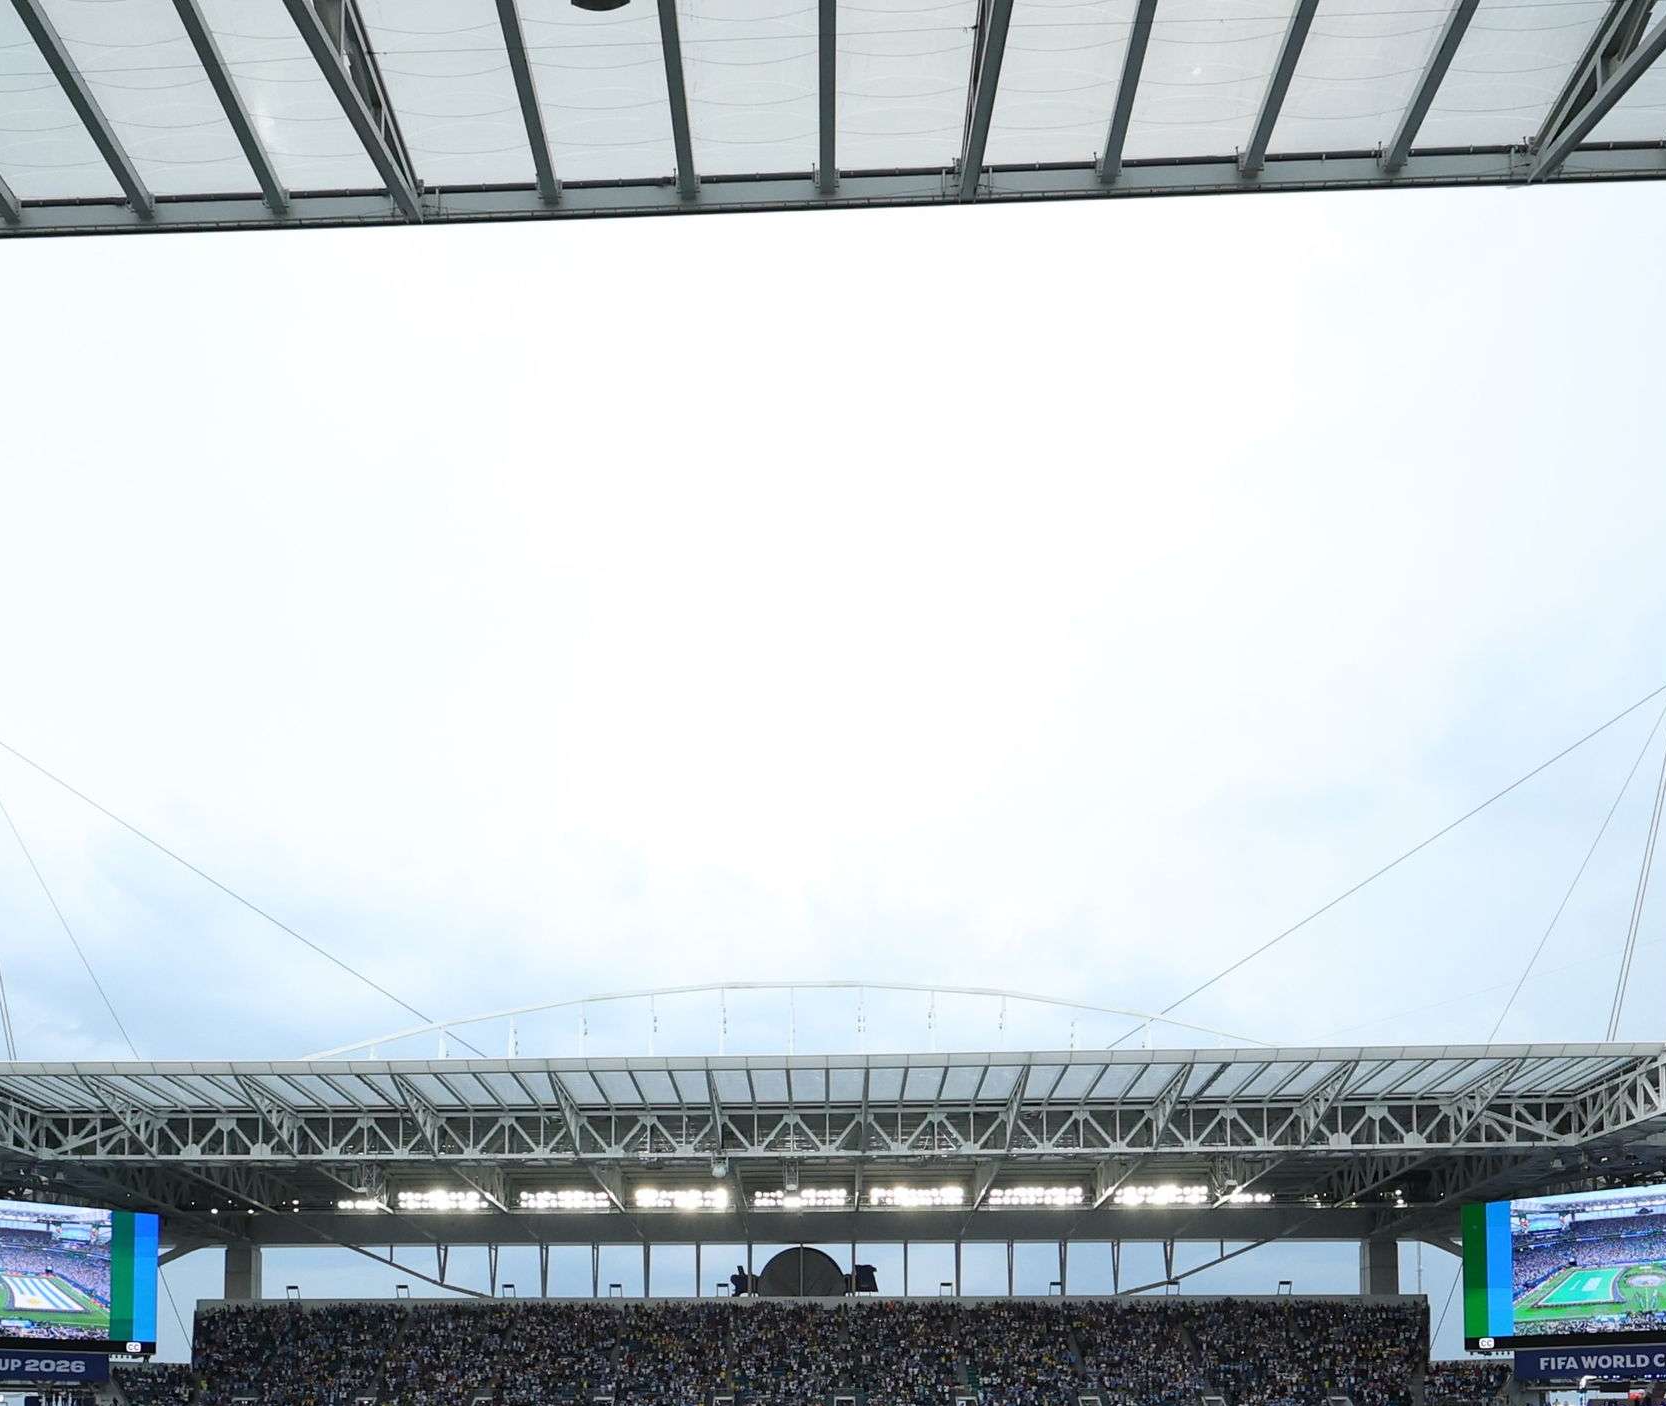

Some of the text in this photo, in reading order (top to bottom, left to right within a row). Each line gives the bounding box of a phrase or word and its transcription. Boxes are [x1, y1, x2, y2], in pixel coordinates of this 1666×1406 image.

[127, 1343, 140, 1351] CC
[1480, 1339, 1493, 1347] CC
[24, 1358, 86, 1373] 2026
[1539, 1355, 1579, 1371] FIFA
[1581, 1353, 1650, 1369] WORLD
